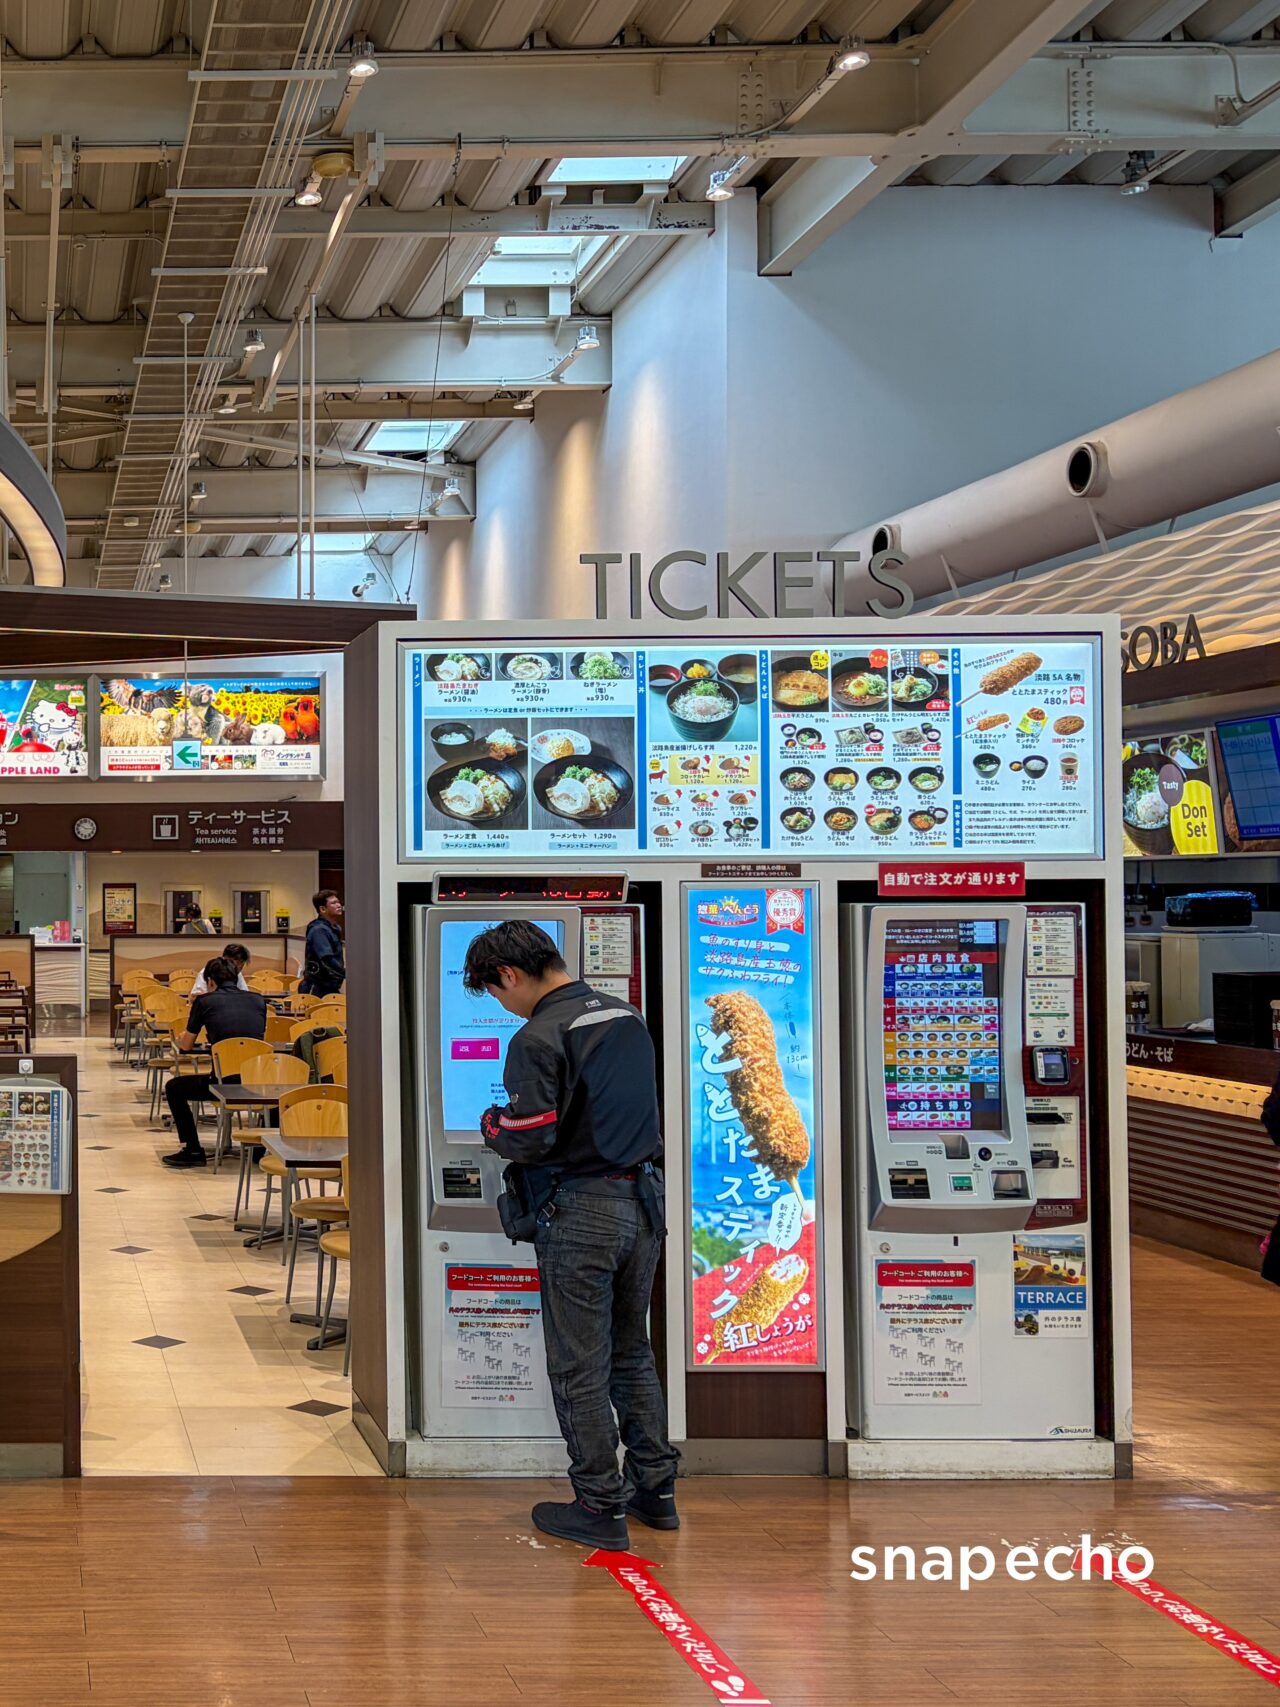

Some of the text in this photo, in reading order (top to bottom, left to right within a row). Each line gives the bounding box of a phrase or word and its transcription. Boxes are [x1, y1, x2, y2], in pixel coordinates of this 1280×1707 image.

[580, 550, 915, 620] TICKETS
[1034, 673, 1050, 681] 淡路
[1065, 673, 1081, 681] 名物
[1044, 697, 1068, 705] 480円
[29, 767, 60, 775] LAND
[1162, 780, 1179, 791] Tasty
[188, 809, 291, 825] ティーサービス
[1181, 803, 1207, 820] Don
[1186, 821, 1208, 838] Set
[884, 871, 1020, 886] 自動で注文が通ります
[709, 933, 776, 953] 魚のすり身と
[918, 953, 970, 963] 店内飲食
[696, 1023, 780, 1200] ととたま
[920, 1101, 972, 1111] 持ち帰り
[710, 1175, 761, 1319] スティック
[1017, 1291, 1084, 1304] TERRACE
[723, 1314, 813, 1352] 紅しょうが
